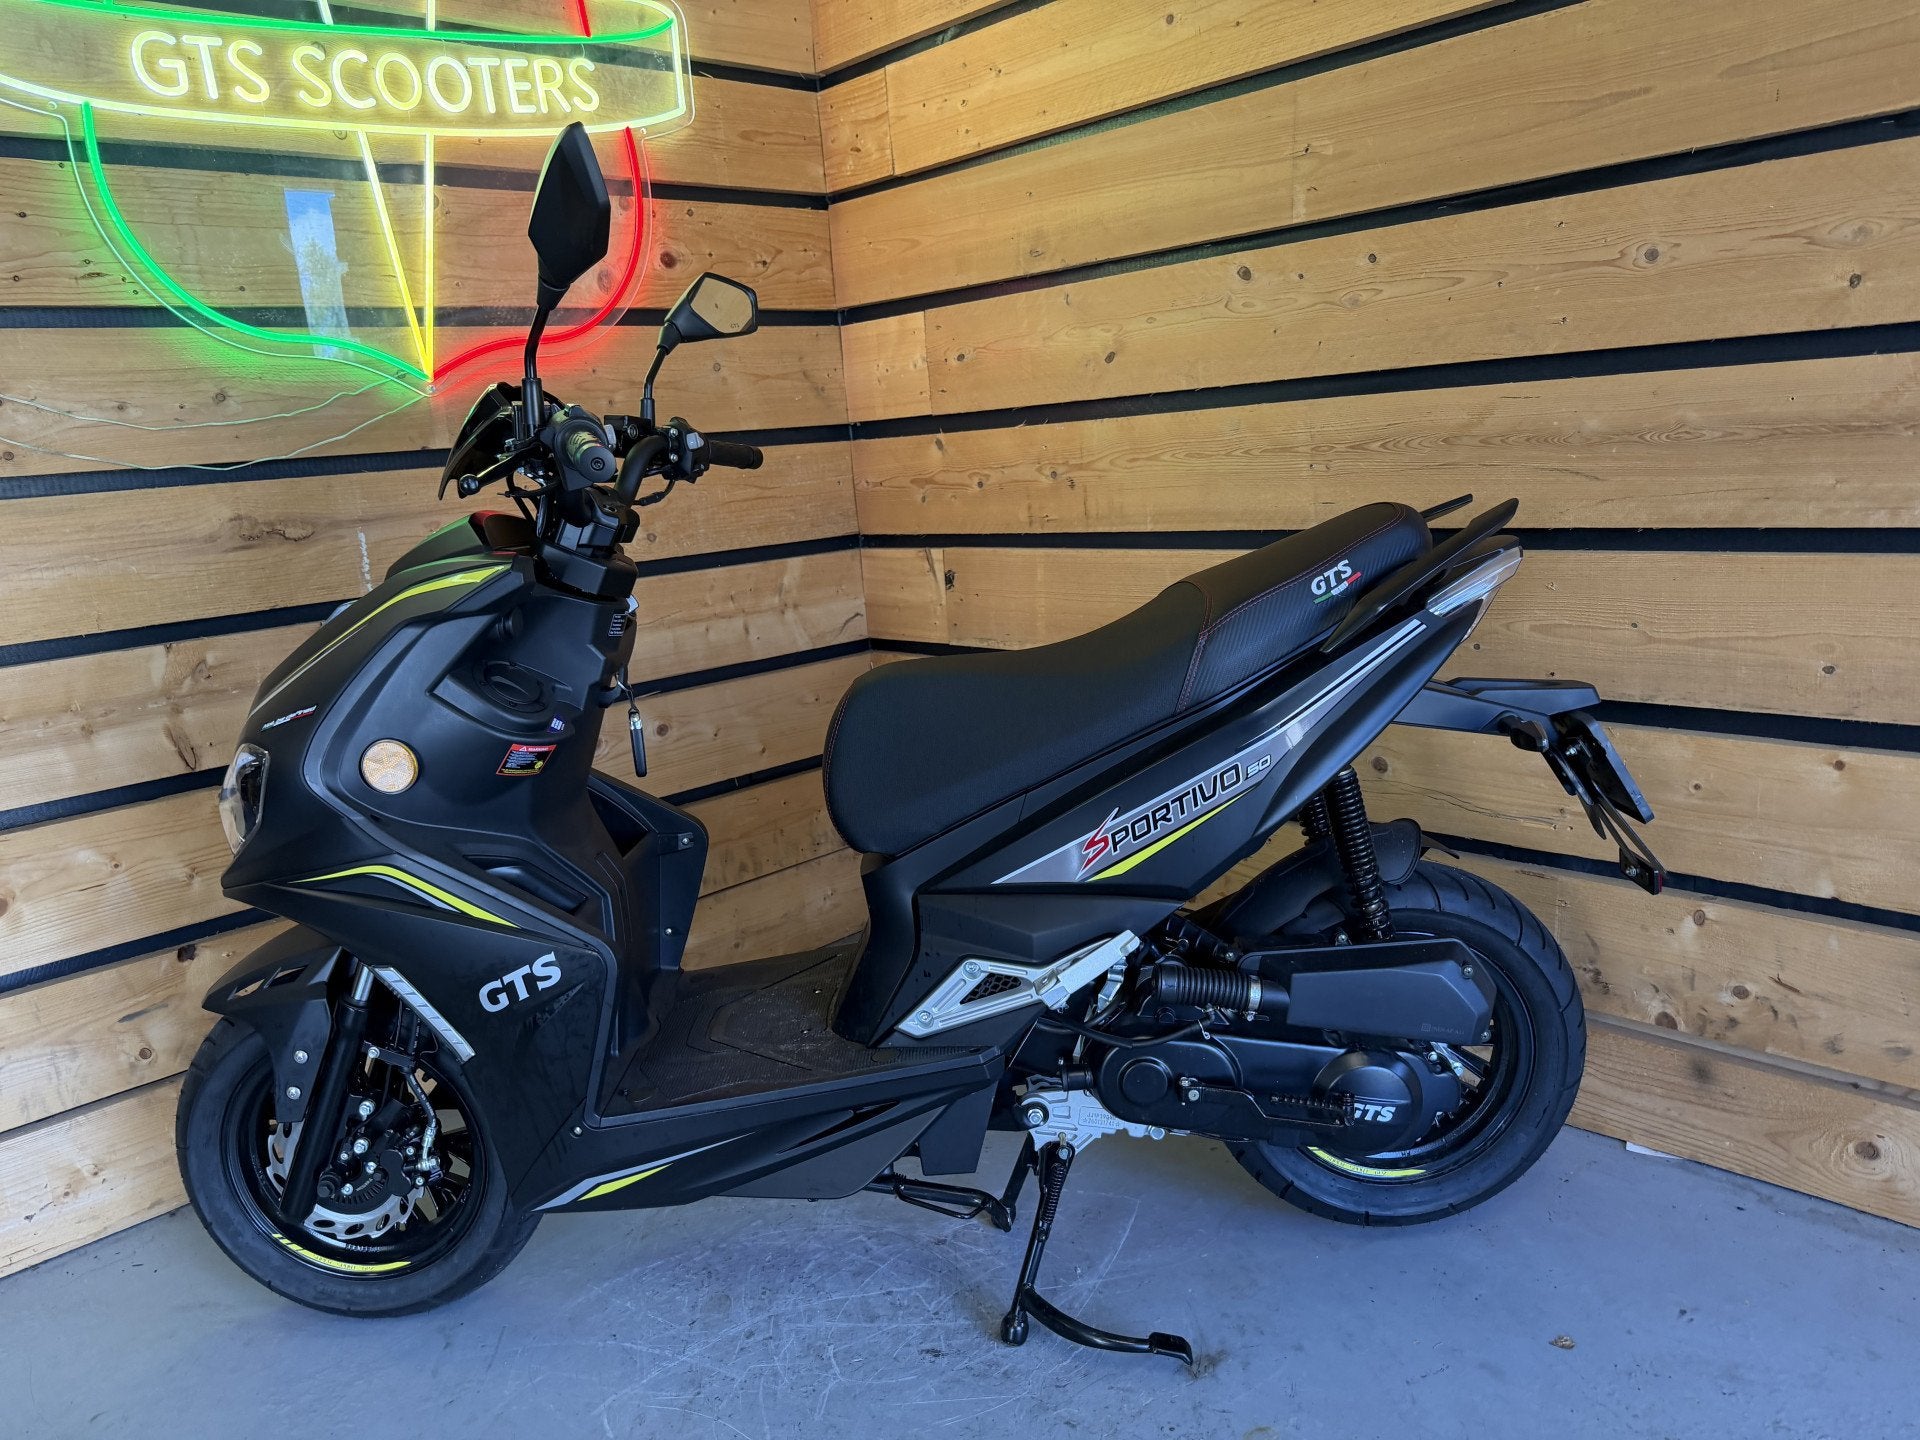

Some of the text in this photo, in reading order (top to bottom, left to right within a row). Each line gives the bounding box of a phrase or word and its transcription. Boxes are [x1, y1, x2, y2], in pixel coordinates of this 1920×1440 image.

[131, 30, 600, 114] GTS SCOOTERS
[1311, 559, 1352, 595] GTS
[1076, 754, 1271, 881] SPORTIVO 50
[479, 951, 562, 1013] GTS
